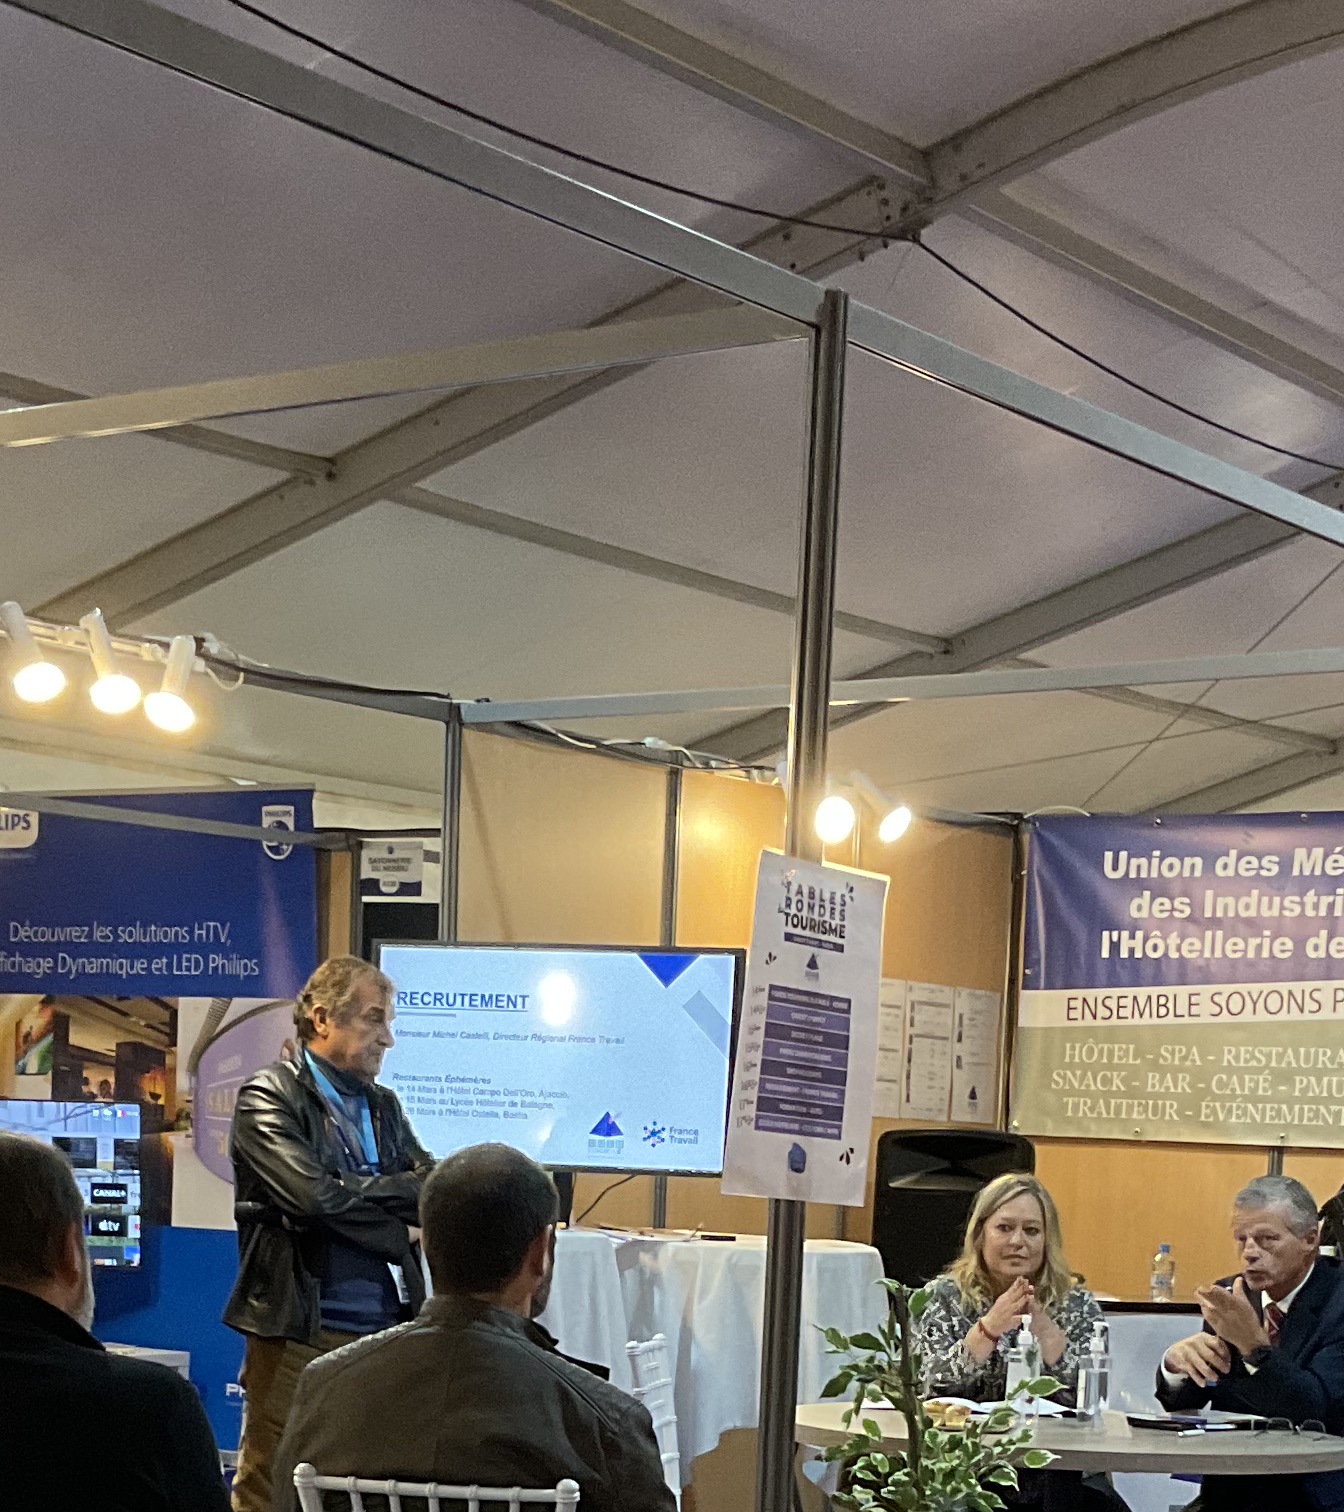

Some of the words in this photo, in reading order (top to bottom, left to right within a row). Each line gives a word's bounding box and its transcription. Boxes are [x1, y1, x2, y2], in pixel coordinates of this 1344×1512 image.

[1103, 850, 1203, 879] Union
[1215, 849, 1279, 877] des
[784, 880, 847, 907] TABLES
[1129, 890, 1191, 919] des
[784, 895, 846, 922] RONDES
[9, 920, 89, 943] Découvrez
[93, 920, 113, 943] les
[117, 921, 190, 943] solutions
[194, 921, 232, 947] HTV,
[784, 911, 846, 939] TOURISME
[1101, 929, 1295, 960] l'Hôtellerie
[57, 952, 147, 979] Dynamique
[151, 956, 167, 976] et
[173, 954, 204, 976] LED
[209, 954, 259, 981] Philips
[396, 991, 530, 1010] RECRUTEMENT
[1066, 992, 1201, 1022] ENSEMBLE
[1209, 987, 1322, 1017] SOYONS
[1063, 1038, 1142, 1065] HÔTEL
[1159, 1045, 1203, 1066] SPA
[1051, 1069, 1128, 1092] SNACK
[1146, 1072, 1192, 1094] BAR
[1211, 1069, 1273, 1096] CAFÉ
[1062, 1097, 1180, 1122] TRAITEUR
[669, 1126, 699, 1136] France
[669, 1135, 699, 1145] Travail
